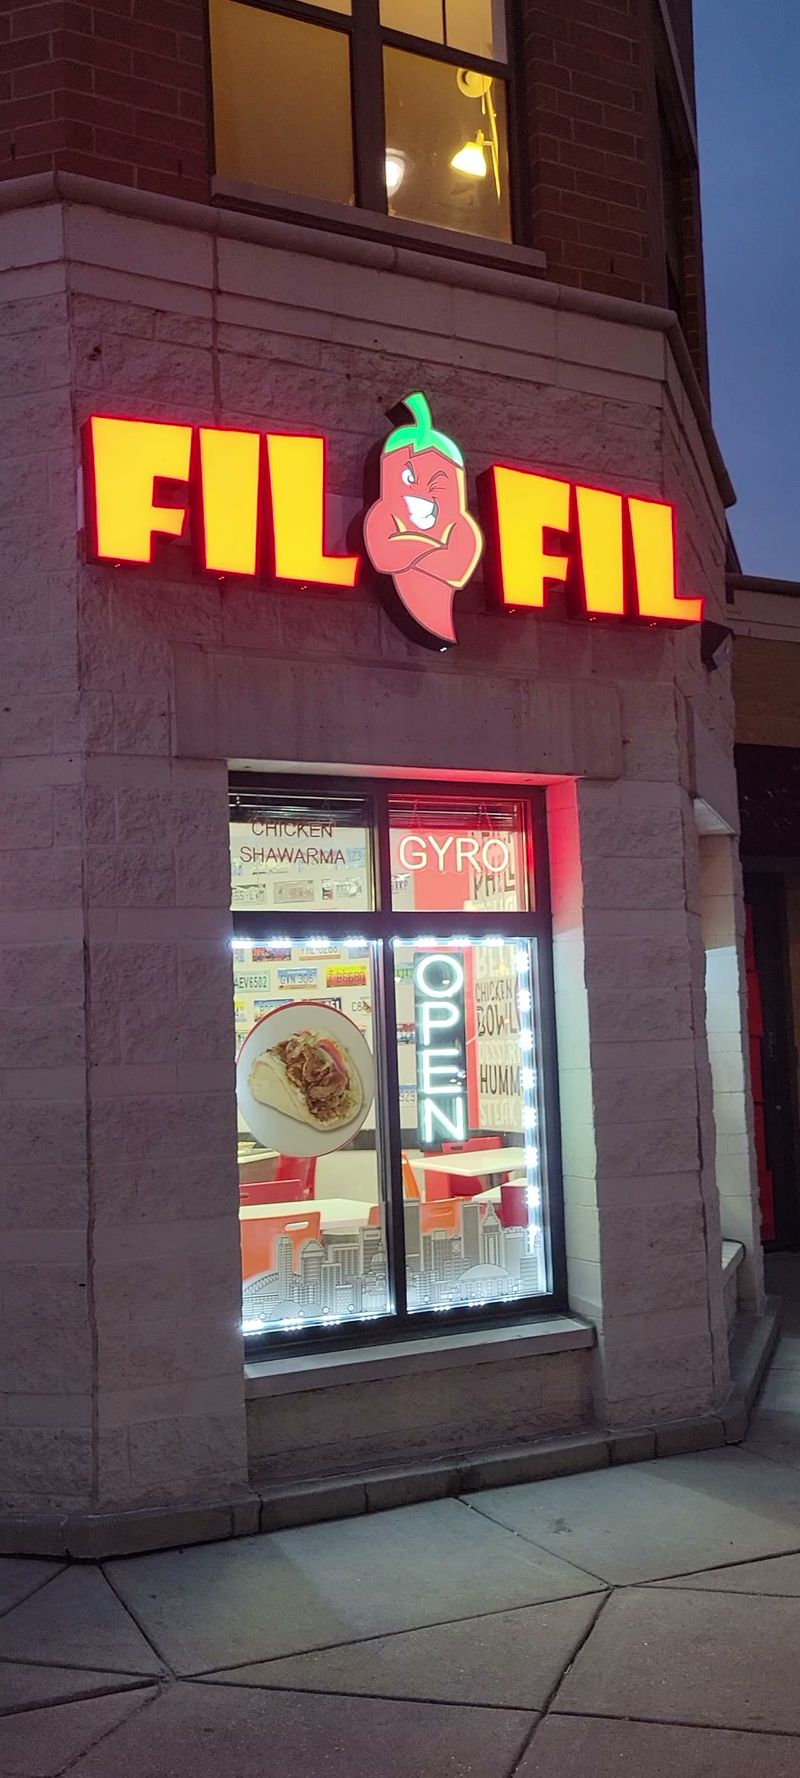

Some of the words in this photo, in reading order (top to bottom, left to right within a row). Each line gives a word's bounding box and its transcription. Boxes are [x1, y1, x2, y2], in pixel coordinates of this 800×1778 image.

[87, 414, 361, 588] FIL
[491, 464, 705, 622] FIL
[250, 818, 334, 838] CHICKEN
[239, 846, 346, 865] SHAWARMA
[399, 835, 510, 873] GYRO
[475, 979, 513, 1003] CHICKEN
[415, 953, 466, 1144] OPEN
